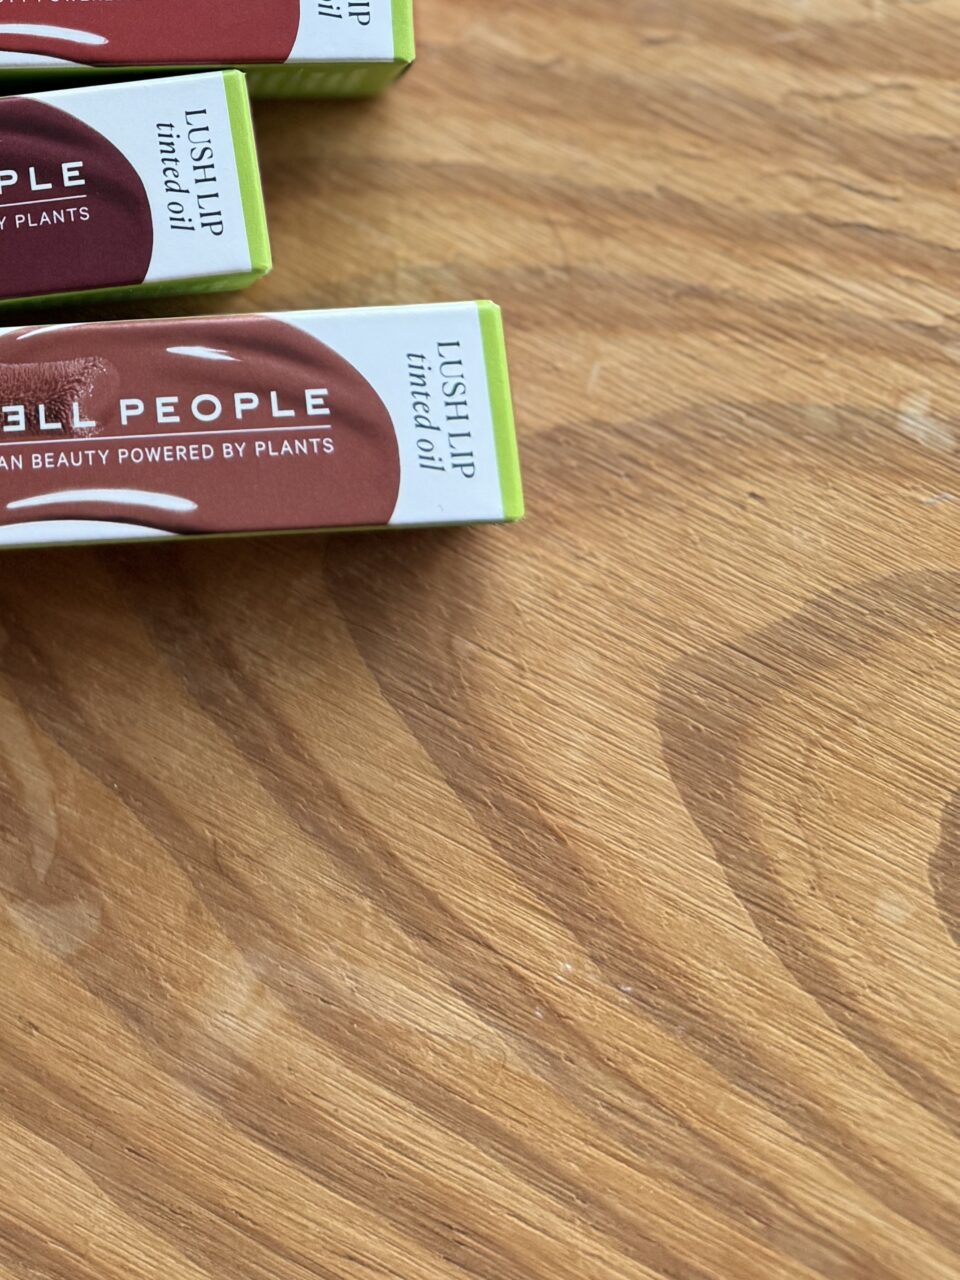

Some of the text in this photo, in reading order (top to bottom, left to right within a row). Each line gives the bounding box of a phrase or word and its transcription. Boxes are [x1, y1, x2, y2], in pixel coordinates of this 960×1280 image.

[16, 206, 89, 228] PLANTS
[156, 123, 195, 230] tinted oil
[185, 109, 224, 236] LUSH LIP
[32, 449, 109, 468] BEAUTY
[118, 444, 214, 464] POWERED
[223, 442, 245, 458] BY
[256, 438, 334, 456] PLANTS
[120, 388, 330, 425] PEOPLE
[406, 353, 446, 472] tinted oil
[437, 341, 475, 478] LUSH LIP
